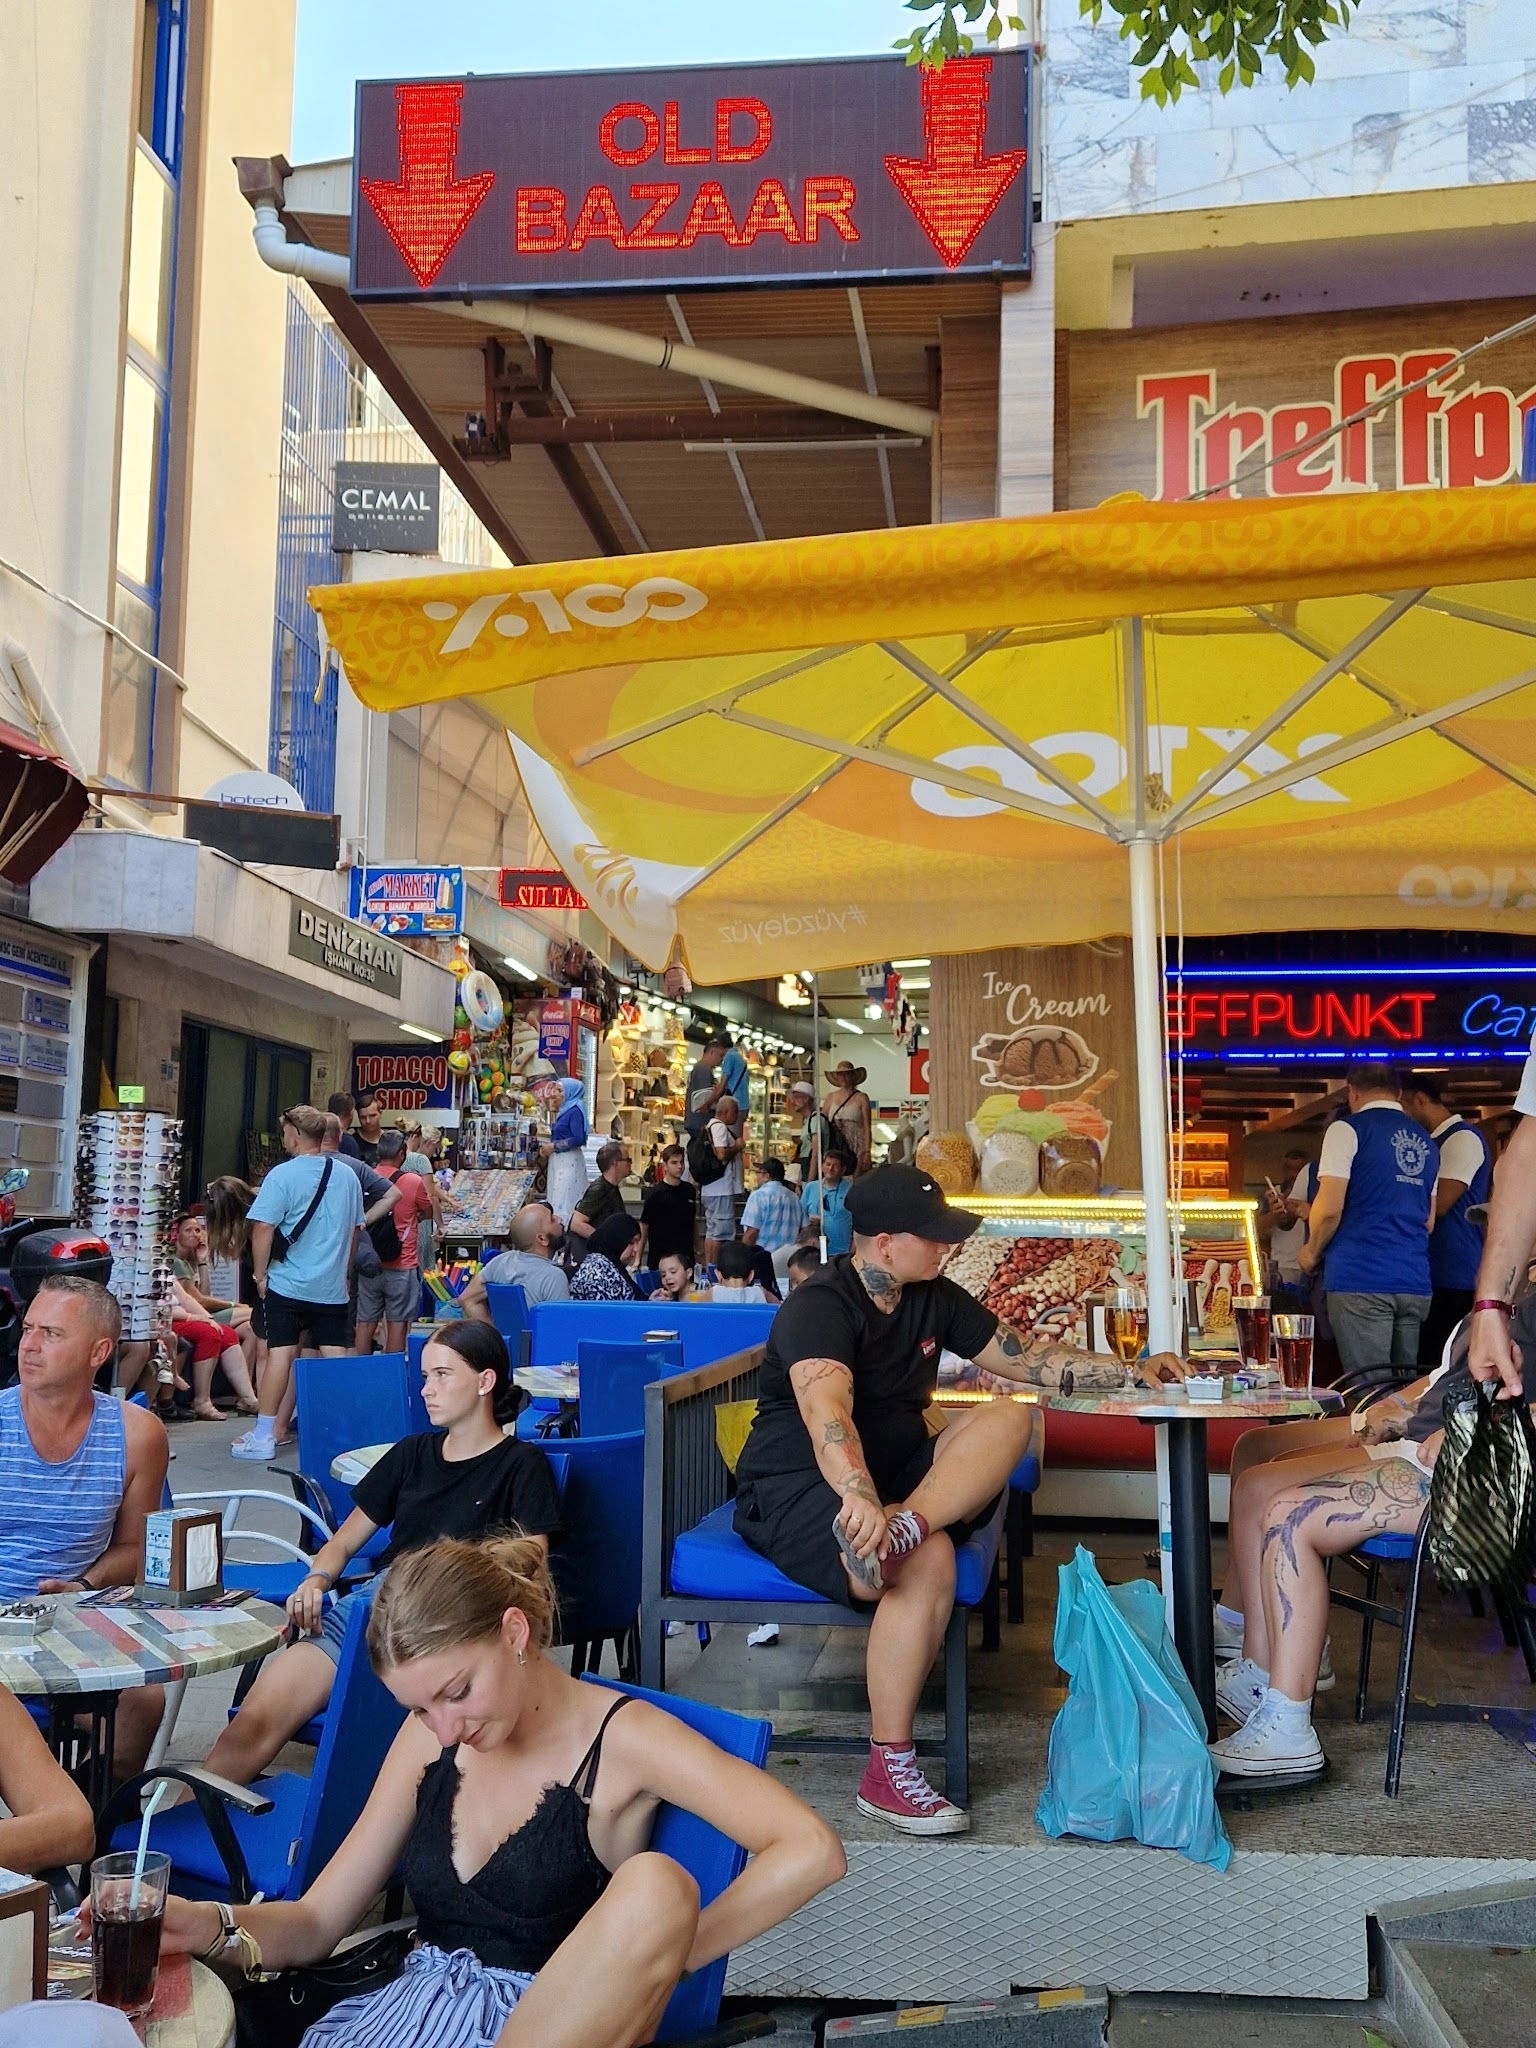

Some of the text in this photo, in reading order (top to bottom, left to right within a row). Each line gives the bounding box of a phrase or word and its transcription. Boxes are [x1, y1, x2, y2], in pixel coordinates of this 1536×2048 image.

[599, 96, 773, 166] OLD
[515, 176, 861, 254] BAZAAR
[1137, 347, 1536, 501] Treffp
[341, 488, 431, 511] CEMAL
[383, 873, 437, 898] MARKET
[299, 908, 398, 976] DENİZHAN
[982, 970, 1112, 1025] Ice Cream
[541, 1024, 570, 1039] TOBACCO
[546, 1036, 564, 1047] SHOP
[356, 1055, 448, 1092] TOBACCO
[374, 1087, 428, 1111] SHOP
